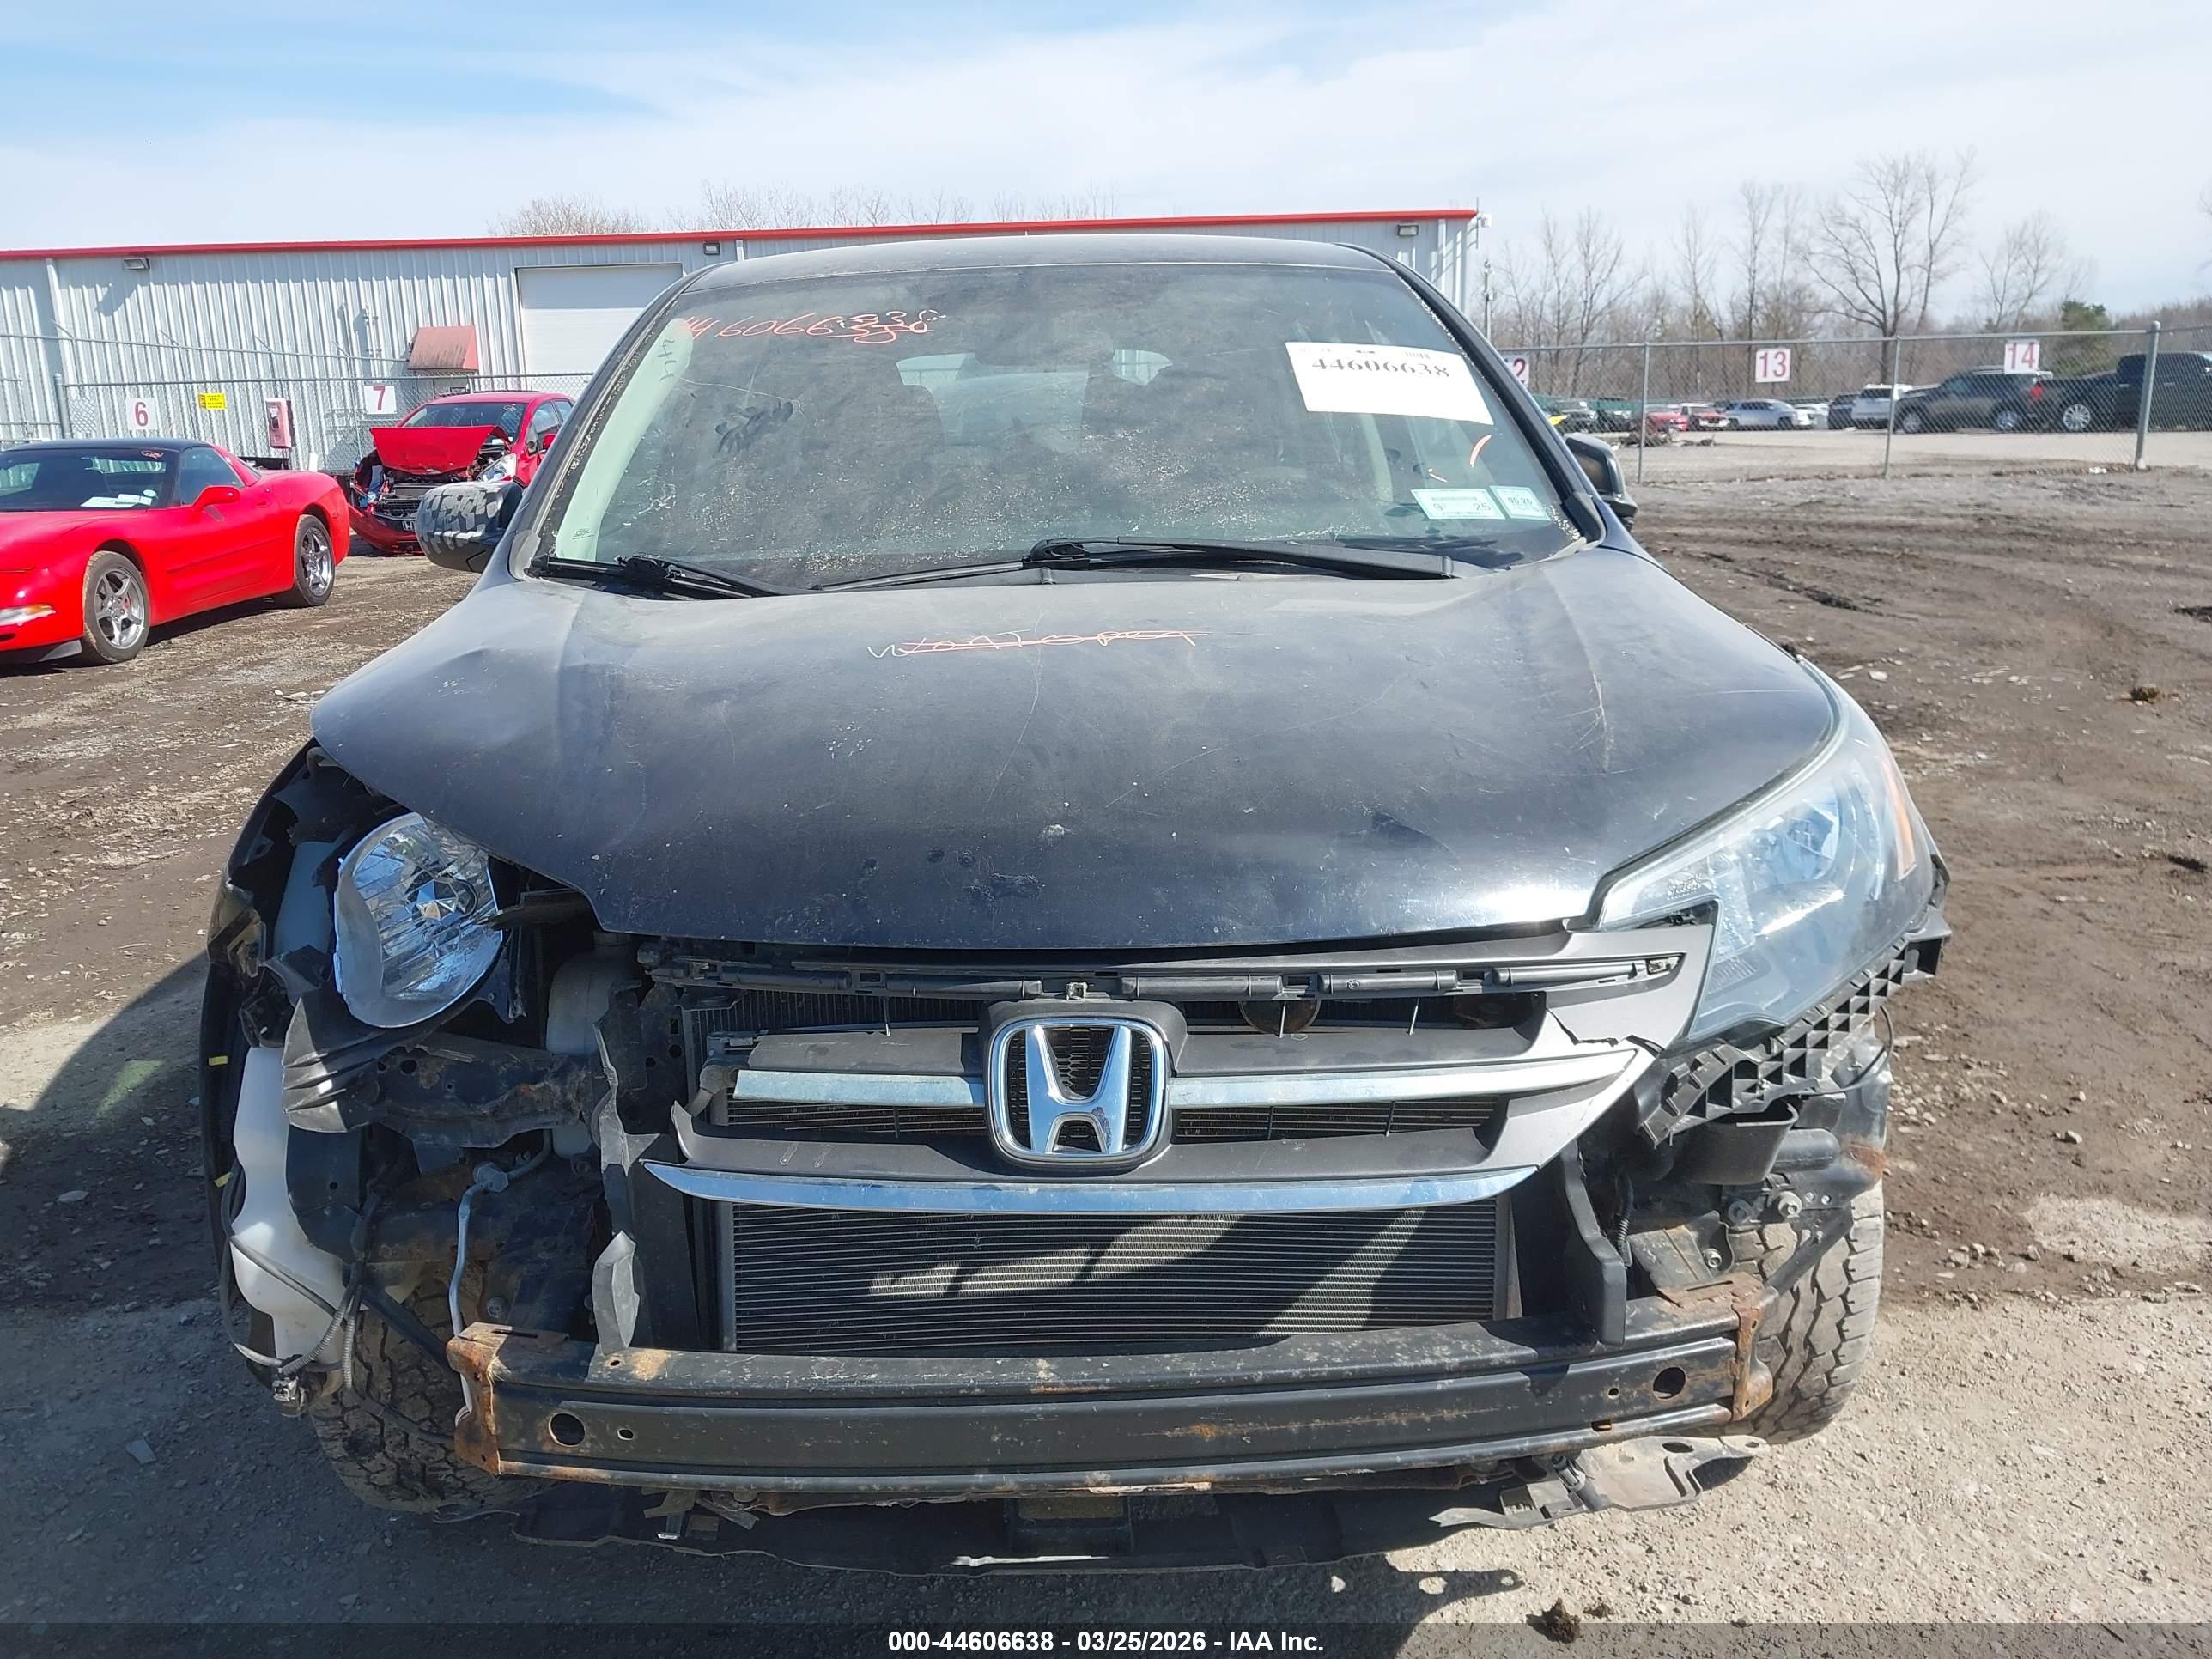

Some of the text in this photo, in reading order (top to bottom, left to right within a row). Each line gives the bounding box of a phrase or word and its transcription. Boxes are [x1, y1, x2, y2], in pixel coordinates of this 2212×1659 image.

[1312, 357, 1450, 378] 44606638
[1759, 351, 1786, 378] 13
[2008, 342, 2035, 369] 14
[1504, 357, 1526, 385] 2
[373, 386, 386, 410] 7
[135, 401, 149, 427] 6
